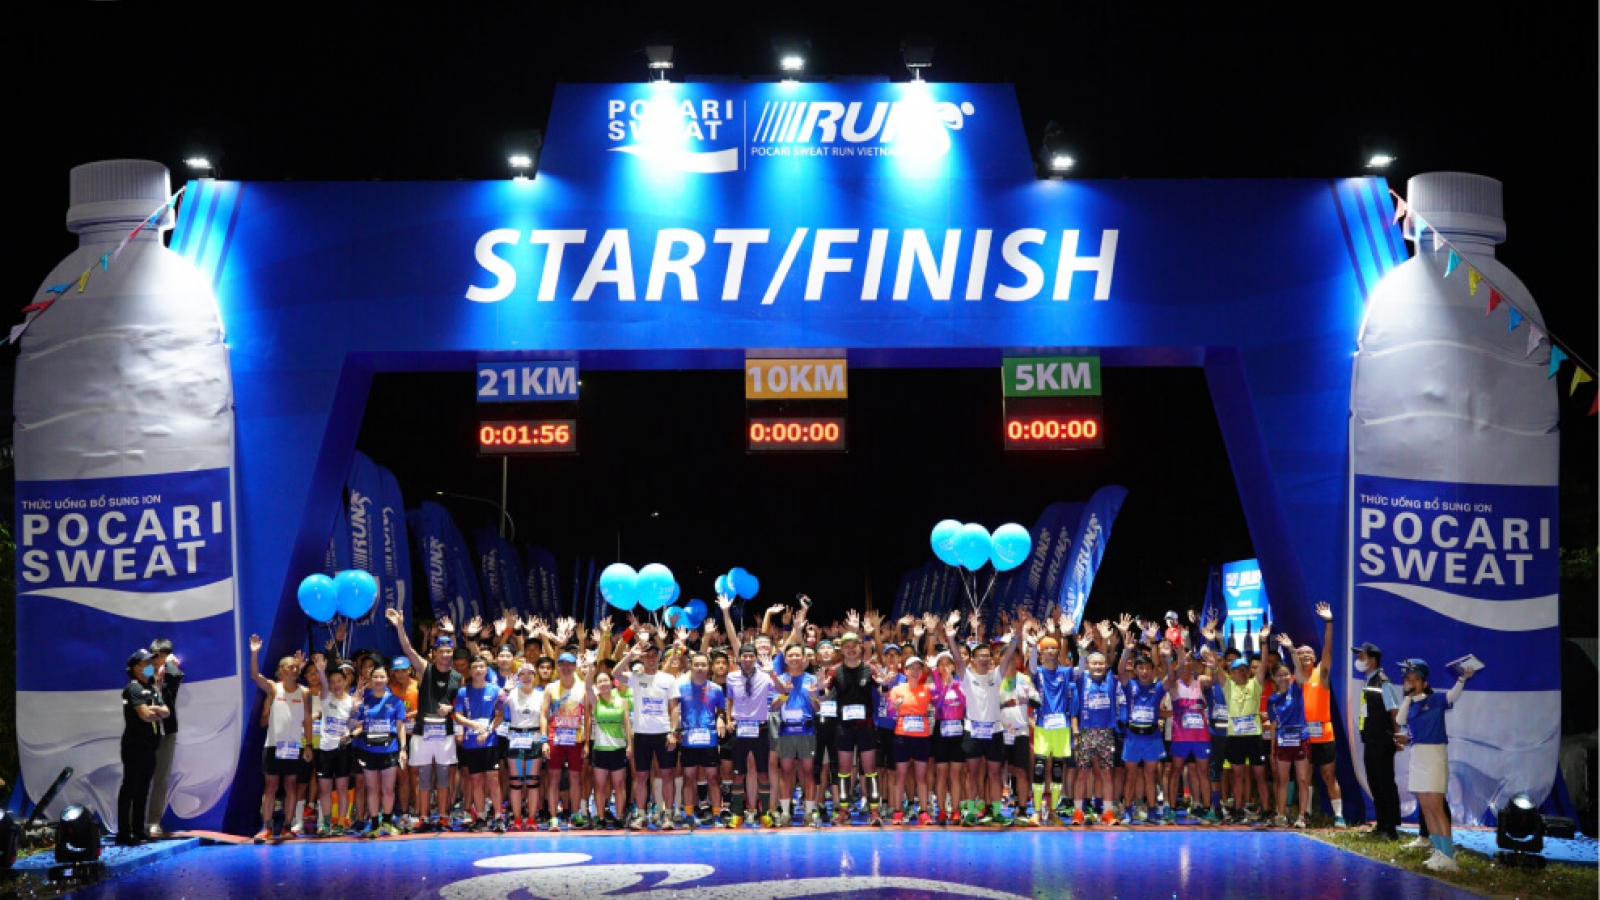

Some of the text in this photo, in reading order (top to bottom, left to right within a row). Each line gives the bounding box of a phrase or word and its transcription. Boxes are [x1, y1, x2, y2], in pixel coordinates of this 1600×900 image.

[608, 99, 734, 120] POARI
[751, 147, 904, 157] POCARI SWEAT RUN VIETNA
[464, 227, 1120, 306] START/FINISH
[478, 366, 577, 397] 21KM
[748, 363, 845, 393] 10KM
[1015, 362, 1092, 392] 5KM
[480, 425, 570, 445] 0:01:56
[750, 422, 840, 442] 0:00:00
[1007, 420, 1098, 440] 0:00:00
[109, 496, 139, 506] SUNG
[142, 494, 161, 504] ION
[1442, 501, 1471, 512] SUNG
[1474, 503, 1493, 513] ION
[22, 501, 223, 547] POCARI
[1360, 507, 1551, 551] POCARI
[22, 540, 207, 583] SWEAT
[1359, 543, 1534, 586] SWEAT
